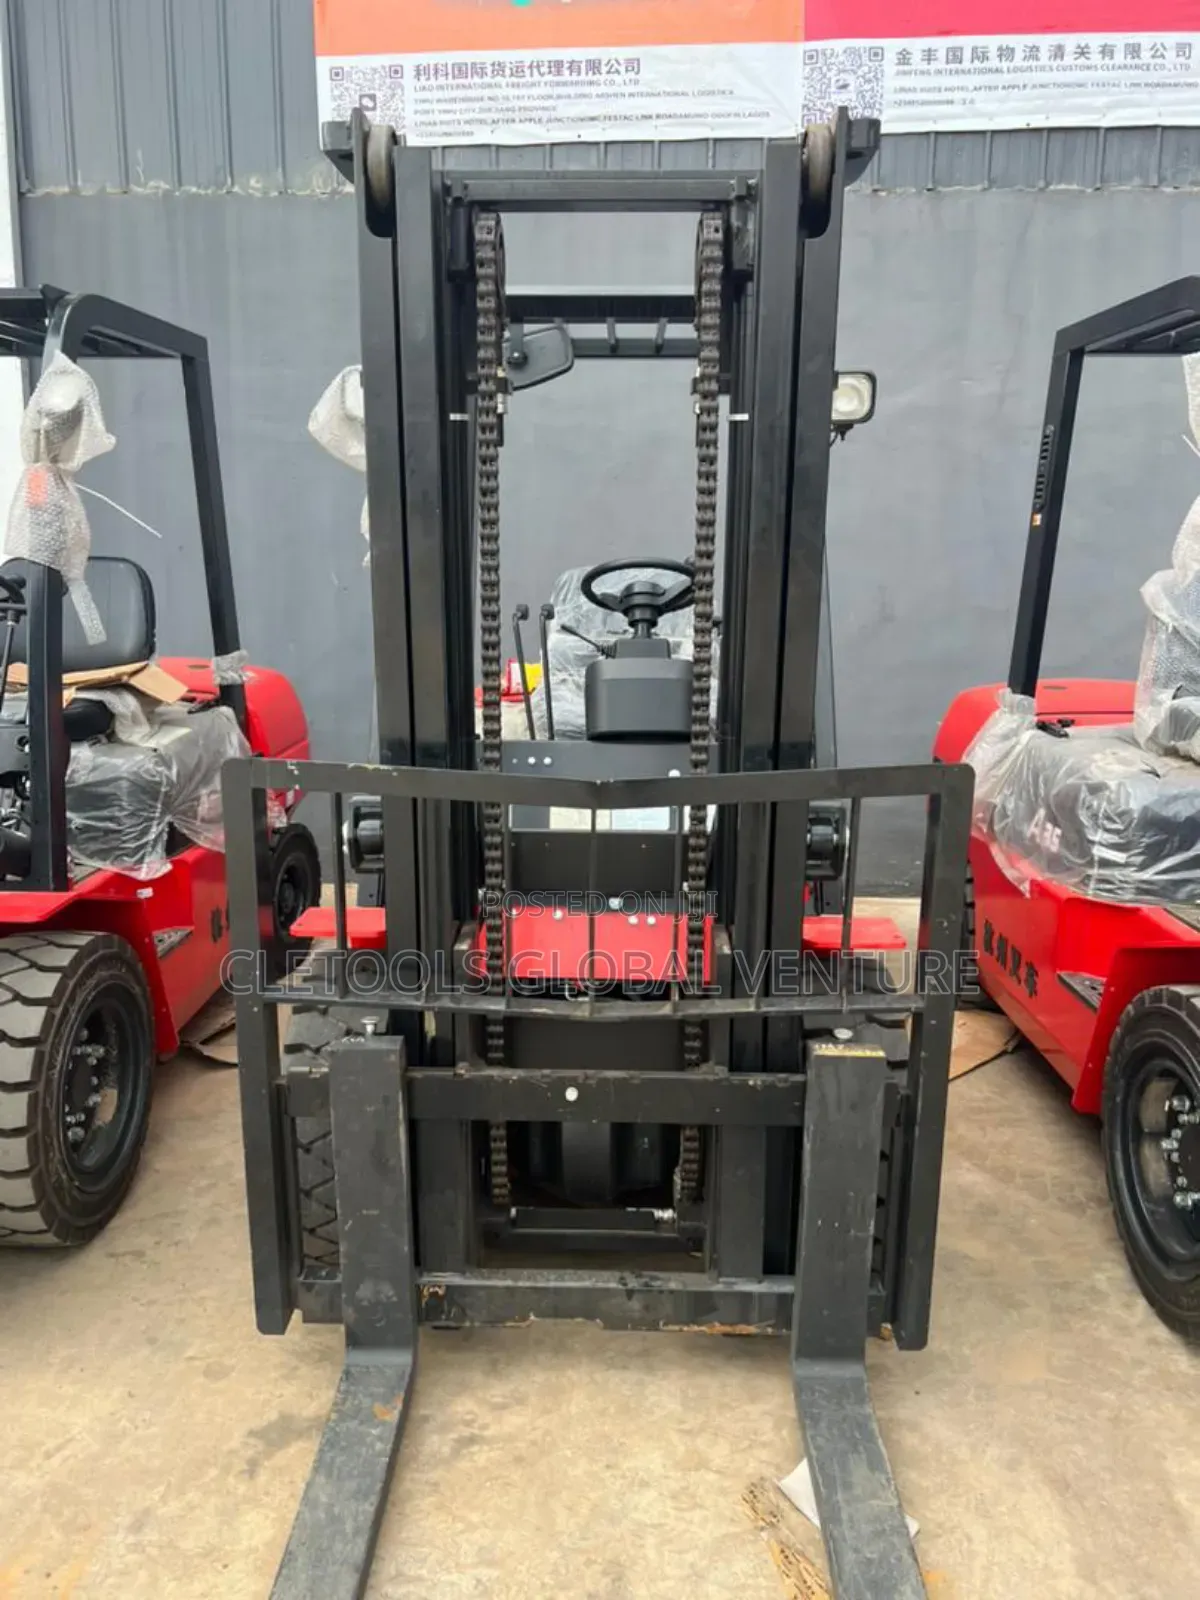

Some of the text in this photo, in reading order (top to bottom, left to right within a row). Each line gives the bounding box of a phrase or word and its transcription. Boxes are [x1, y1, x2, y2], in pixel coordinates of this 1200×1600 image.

[895, 42, 1192, 66] 金丰国际物流清关有限公司
[412, 57, 642, 82] 利科国际货运代理有限公司
[933, 66, 1004, 75] INTERNATIONAL
[1006, 64, 1054, 74] LOGISTICS
[1055, 63, 1099, 72] CUSTOMS
[1100, 62, 1151, 72] CLEARANCE
